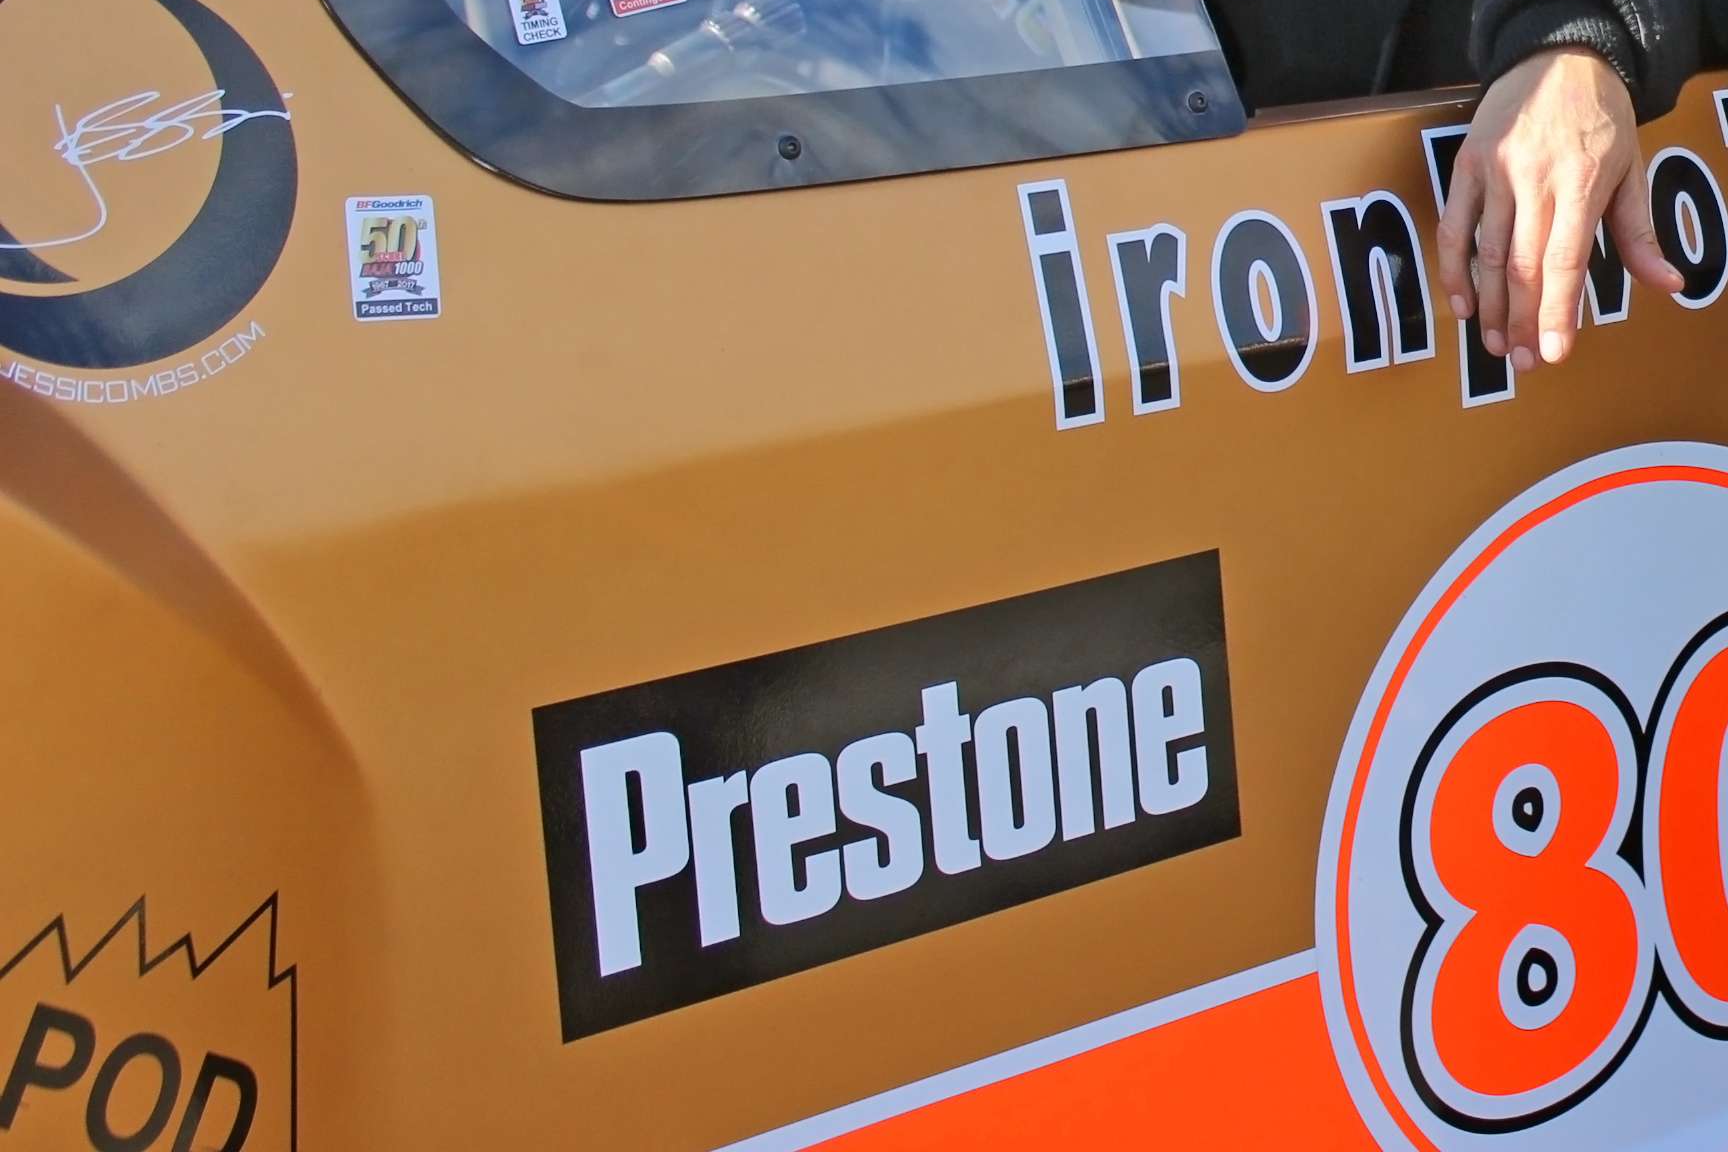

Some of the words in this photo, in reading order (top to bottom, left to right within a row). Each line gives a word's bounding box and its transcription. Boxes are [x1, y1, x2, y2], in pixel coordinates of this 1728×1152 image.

[521, 16, 559, 31] TIMING
[523, 27, 562, 42] CHECK
[357, 199, 423, 209] BFGoodrich
[394, 261, 424, 276] 1000
[361, 302, 403, 314] Passed
[406, 300, 433, 312] Tech
[0, 320, 266, 404] JESSICOMBS.COM
[580, 657, 1208, 977] Prestone
